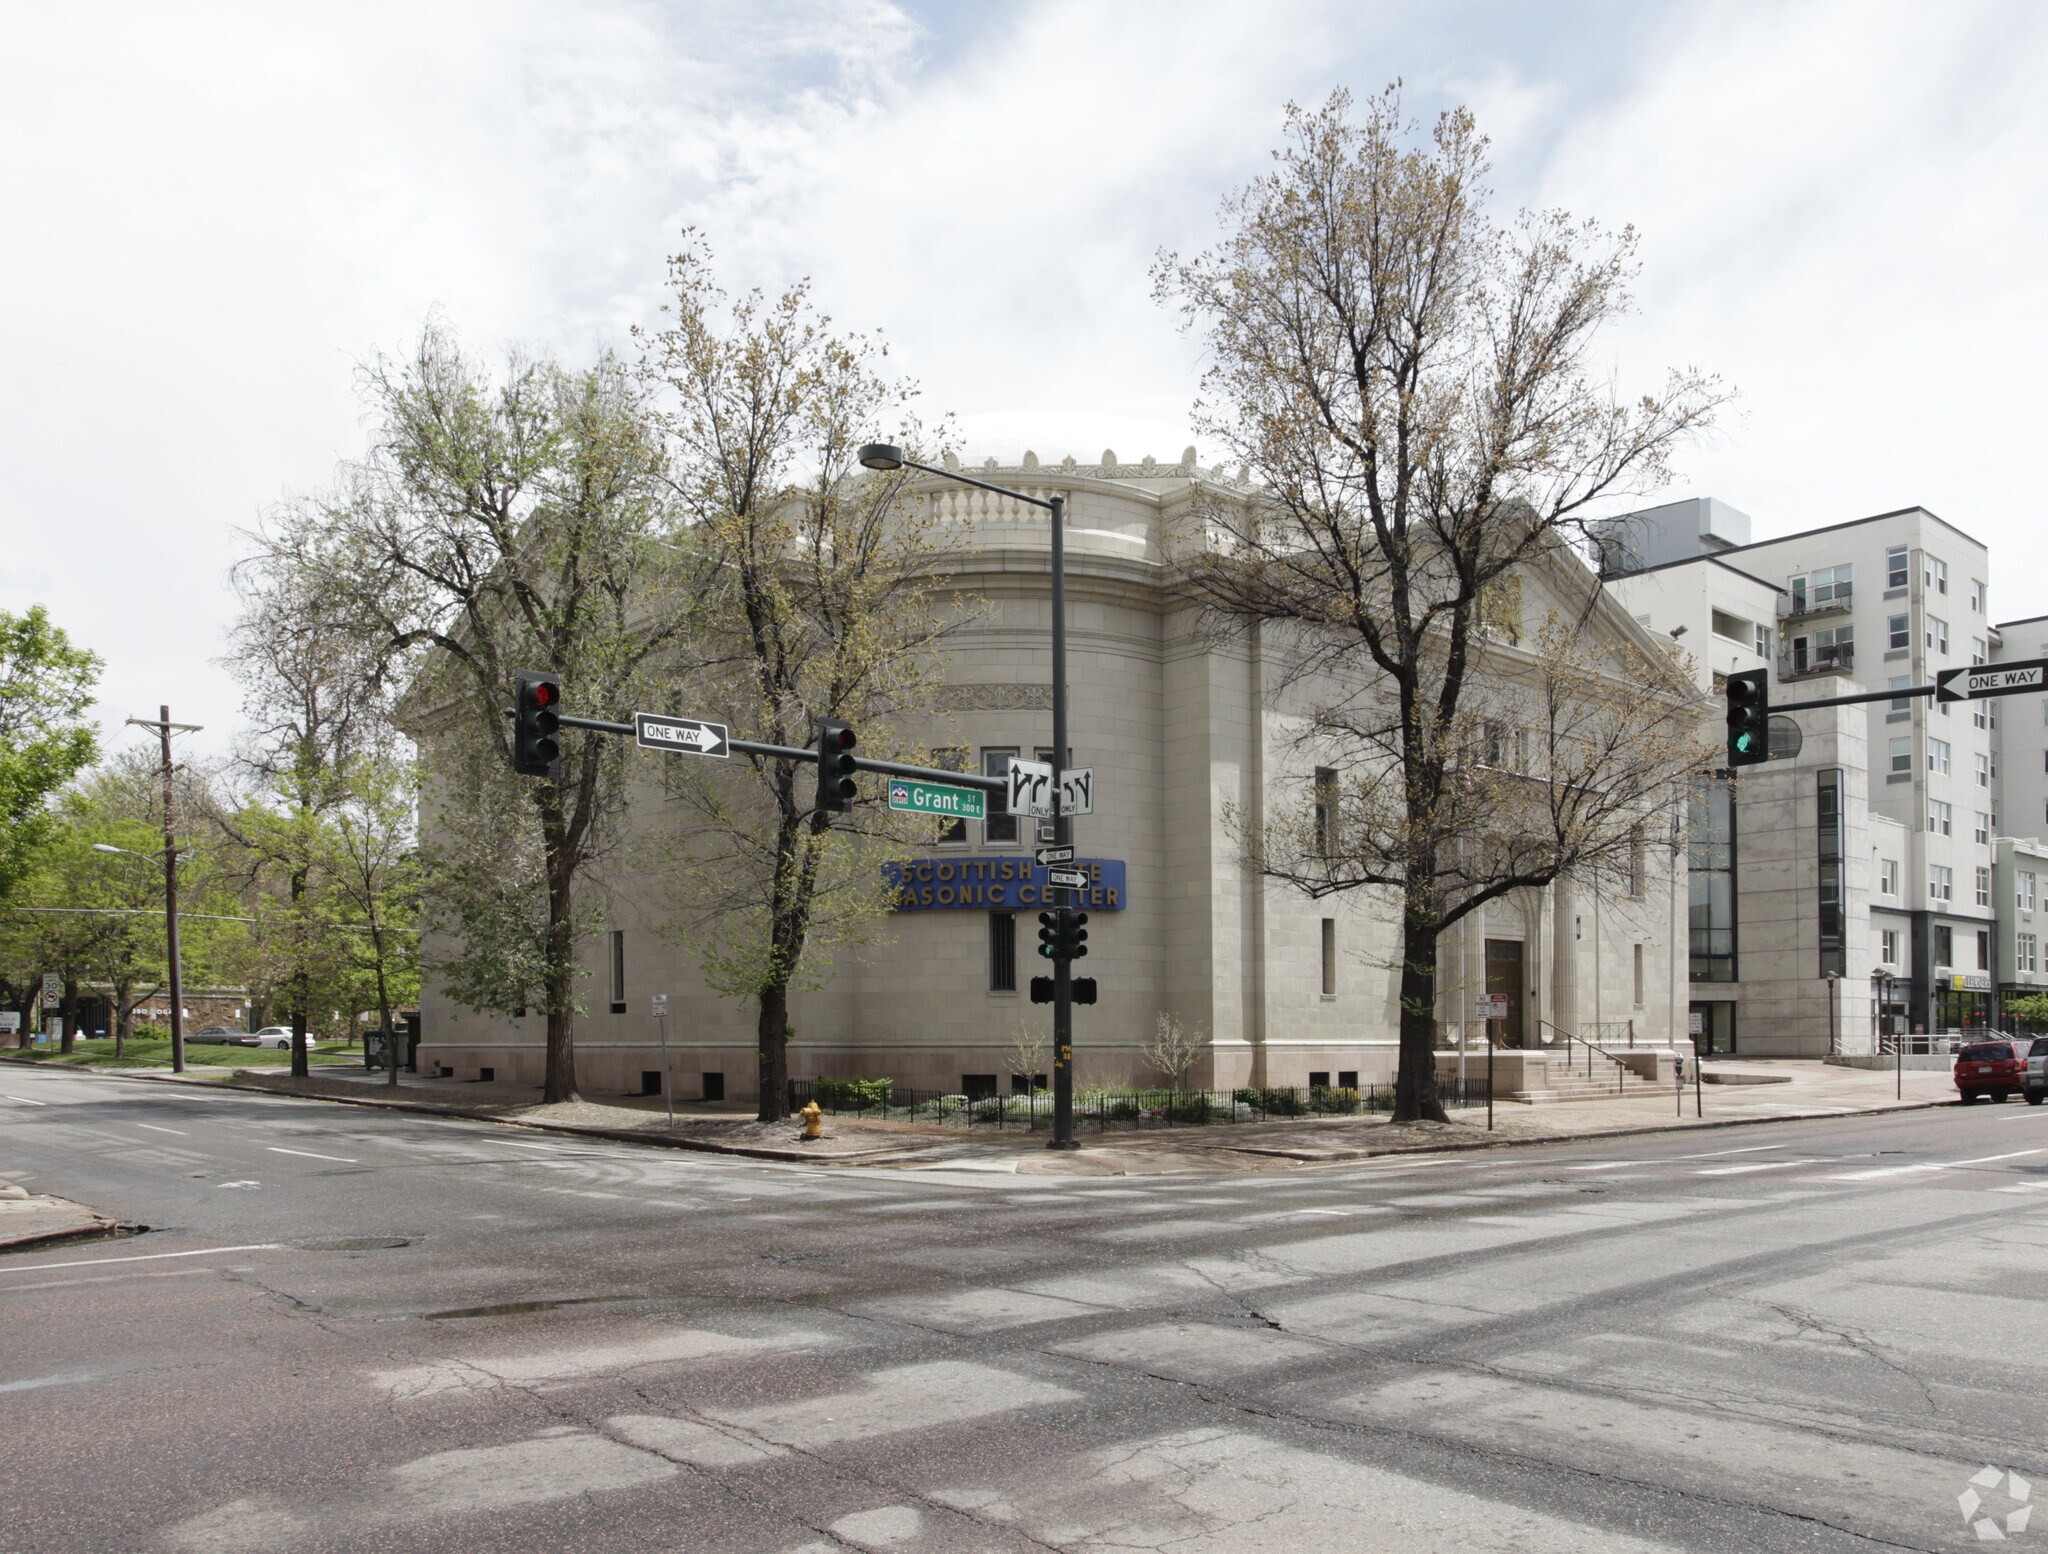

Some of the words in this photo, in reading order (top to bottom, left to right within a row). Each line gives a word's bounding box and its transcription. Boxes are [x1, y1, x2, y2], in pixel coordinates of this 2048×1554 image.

[1969, 675, 1999, 689] ONE
[2005, 670, 2038, 685] WAY
[647, 725, 671, 739] ONE
[676, 729, 700, 742] WAY
[913, 787, 958, 810] Grant
[967, 794, 976, 803] ST
[962, 803, 975, 813] 300
[976, 805, 981, 814] E
[1031, 805, 1049, 816] ONLY
[1061, 804, 1076, 813] ONLY
[1046, 852, 1057, 860] ONE
[1059, 850, 1070, 858] WAY
[901, 861, 1032, 883] SCOTTISH
[1053, 873, 1064, 881] ONE
[903, 884, 1006, 905] ASONIC
[1018, 885, 1119, 905] CETER
